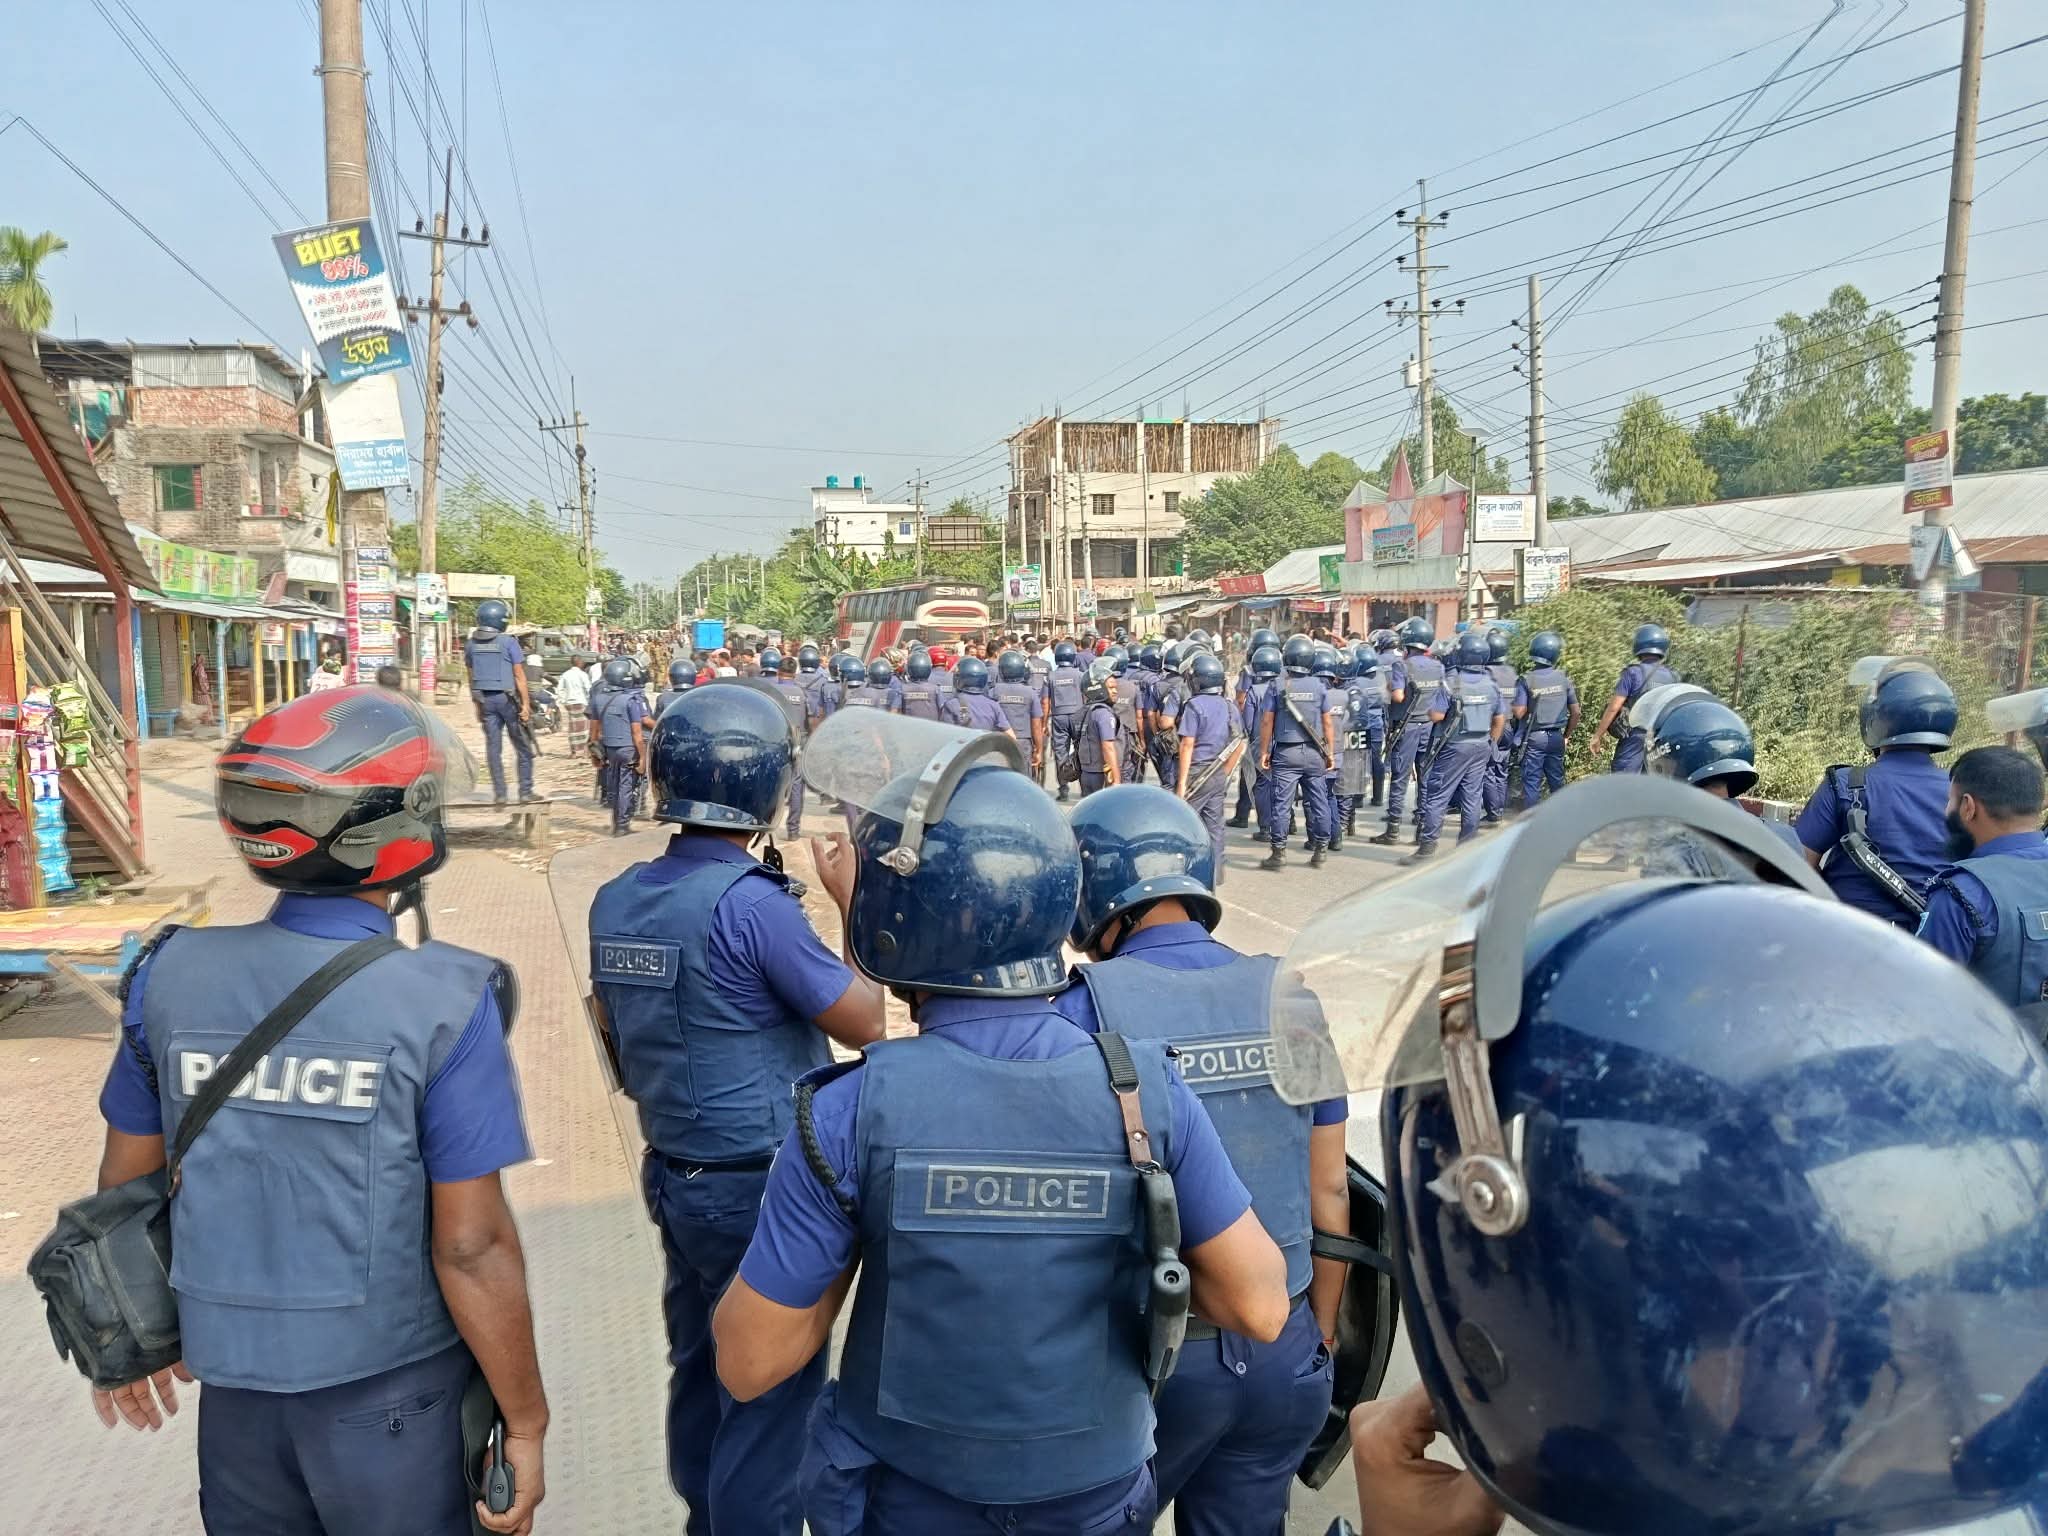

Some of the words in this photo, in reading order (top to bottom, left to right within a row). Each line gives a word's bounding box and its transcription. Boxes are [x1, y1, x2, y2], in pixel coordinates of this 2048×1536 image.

[295, 227, 361, 267] BUET
[1533, 685, 1563, 697] POLICE
[1344, 731, 1366, 750] ICE
[605, 948, 659, 970] POLICE
[1181, 1045, 1277, 1077] POLICE
[944, 1175, 1089, 1209] POLICE
